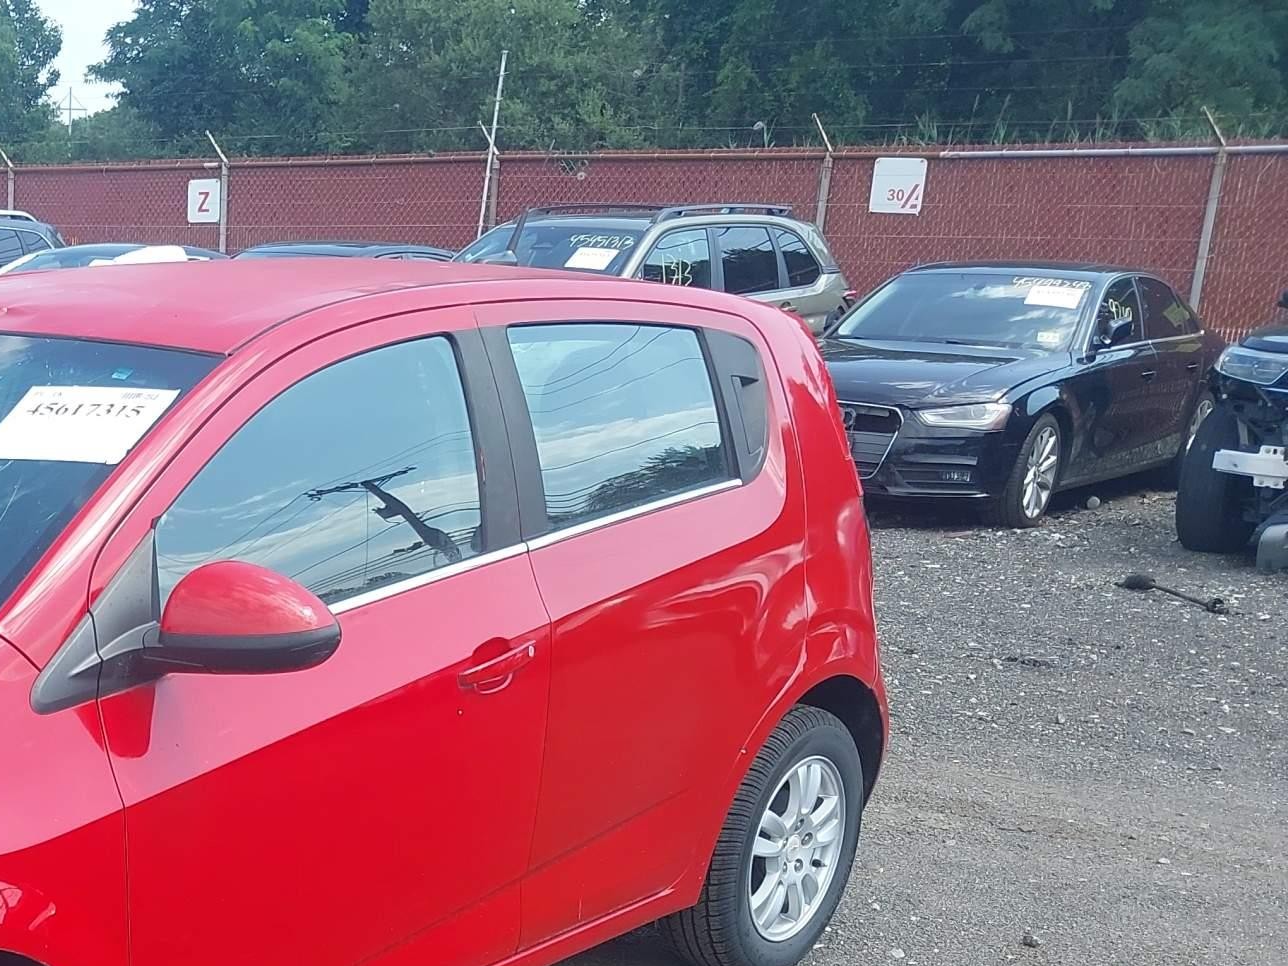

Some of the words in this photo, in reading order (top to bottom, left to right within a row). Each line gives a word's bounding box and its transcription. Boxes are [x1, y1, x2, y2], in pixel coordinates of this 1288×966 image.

[197, 191, 210, 213] Z
[887, 188, 905, 202] 30
[26, 402, 146, 418] 45617315
